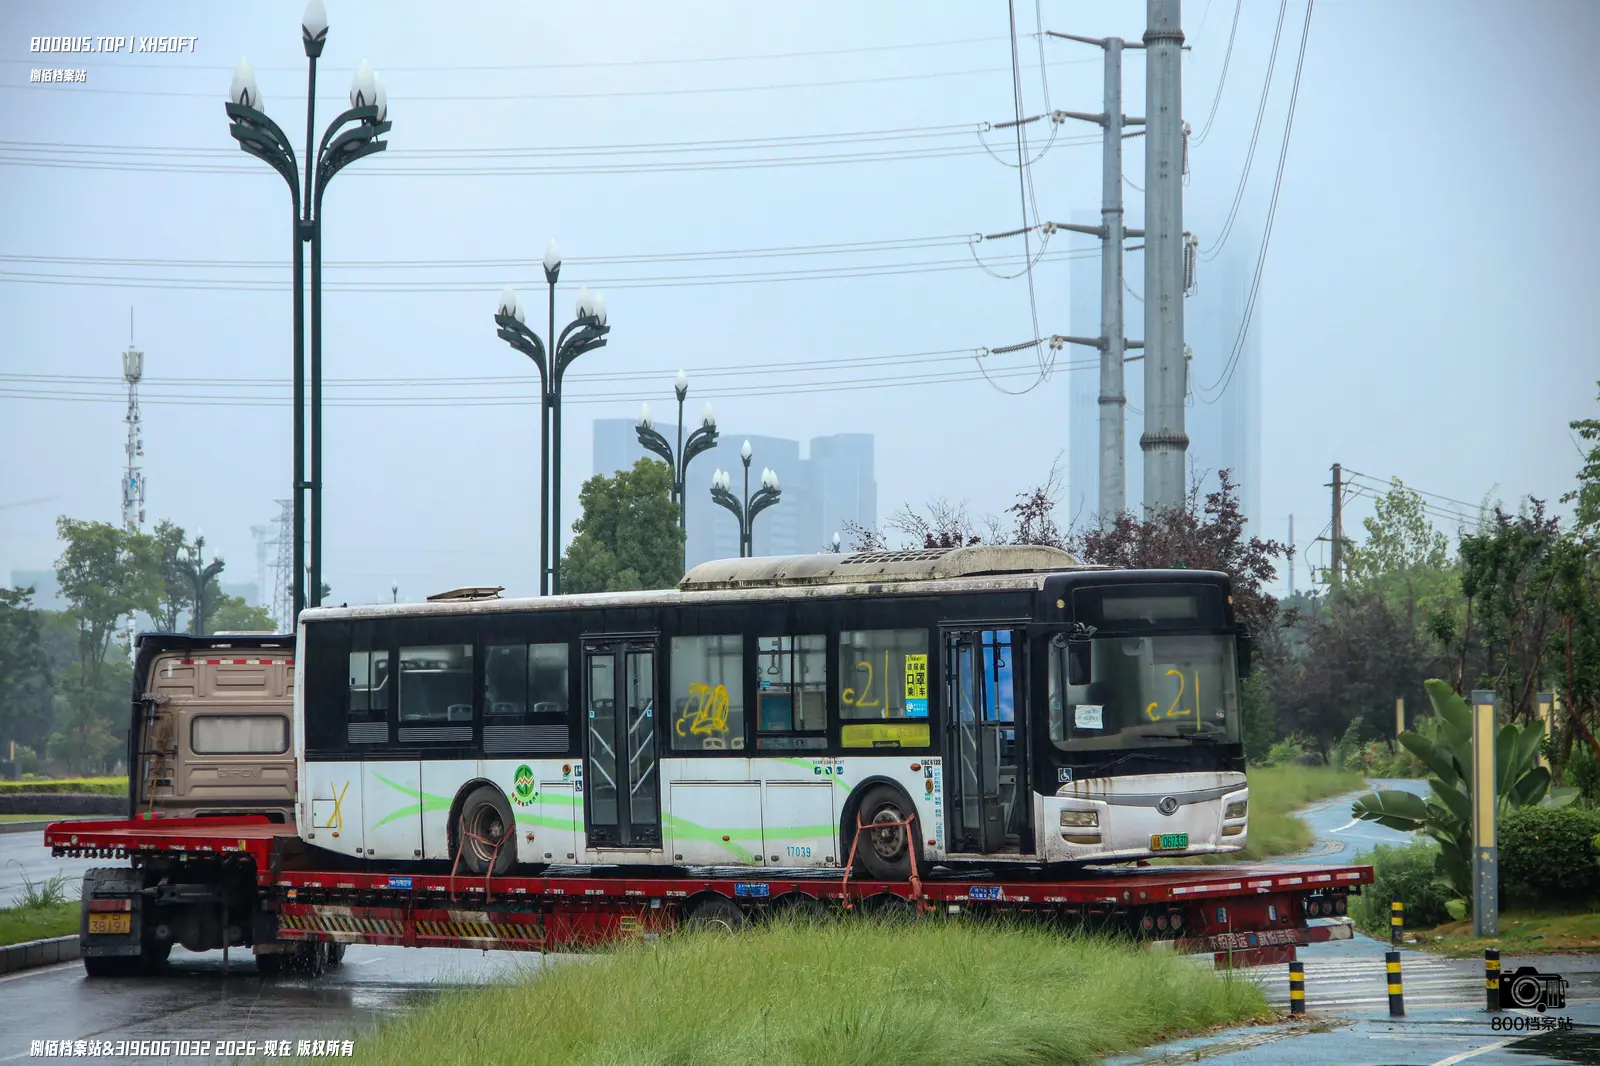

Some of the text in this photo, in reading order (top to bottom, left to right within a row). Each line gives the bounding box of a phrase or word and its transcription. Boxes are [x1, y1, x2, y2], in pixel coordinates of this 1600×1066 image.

[907, 672, 925, 685] 口罩
[786, 846, 811, 858] 17039
[90, 921, 127, 933] 38191
